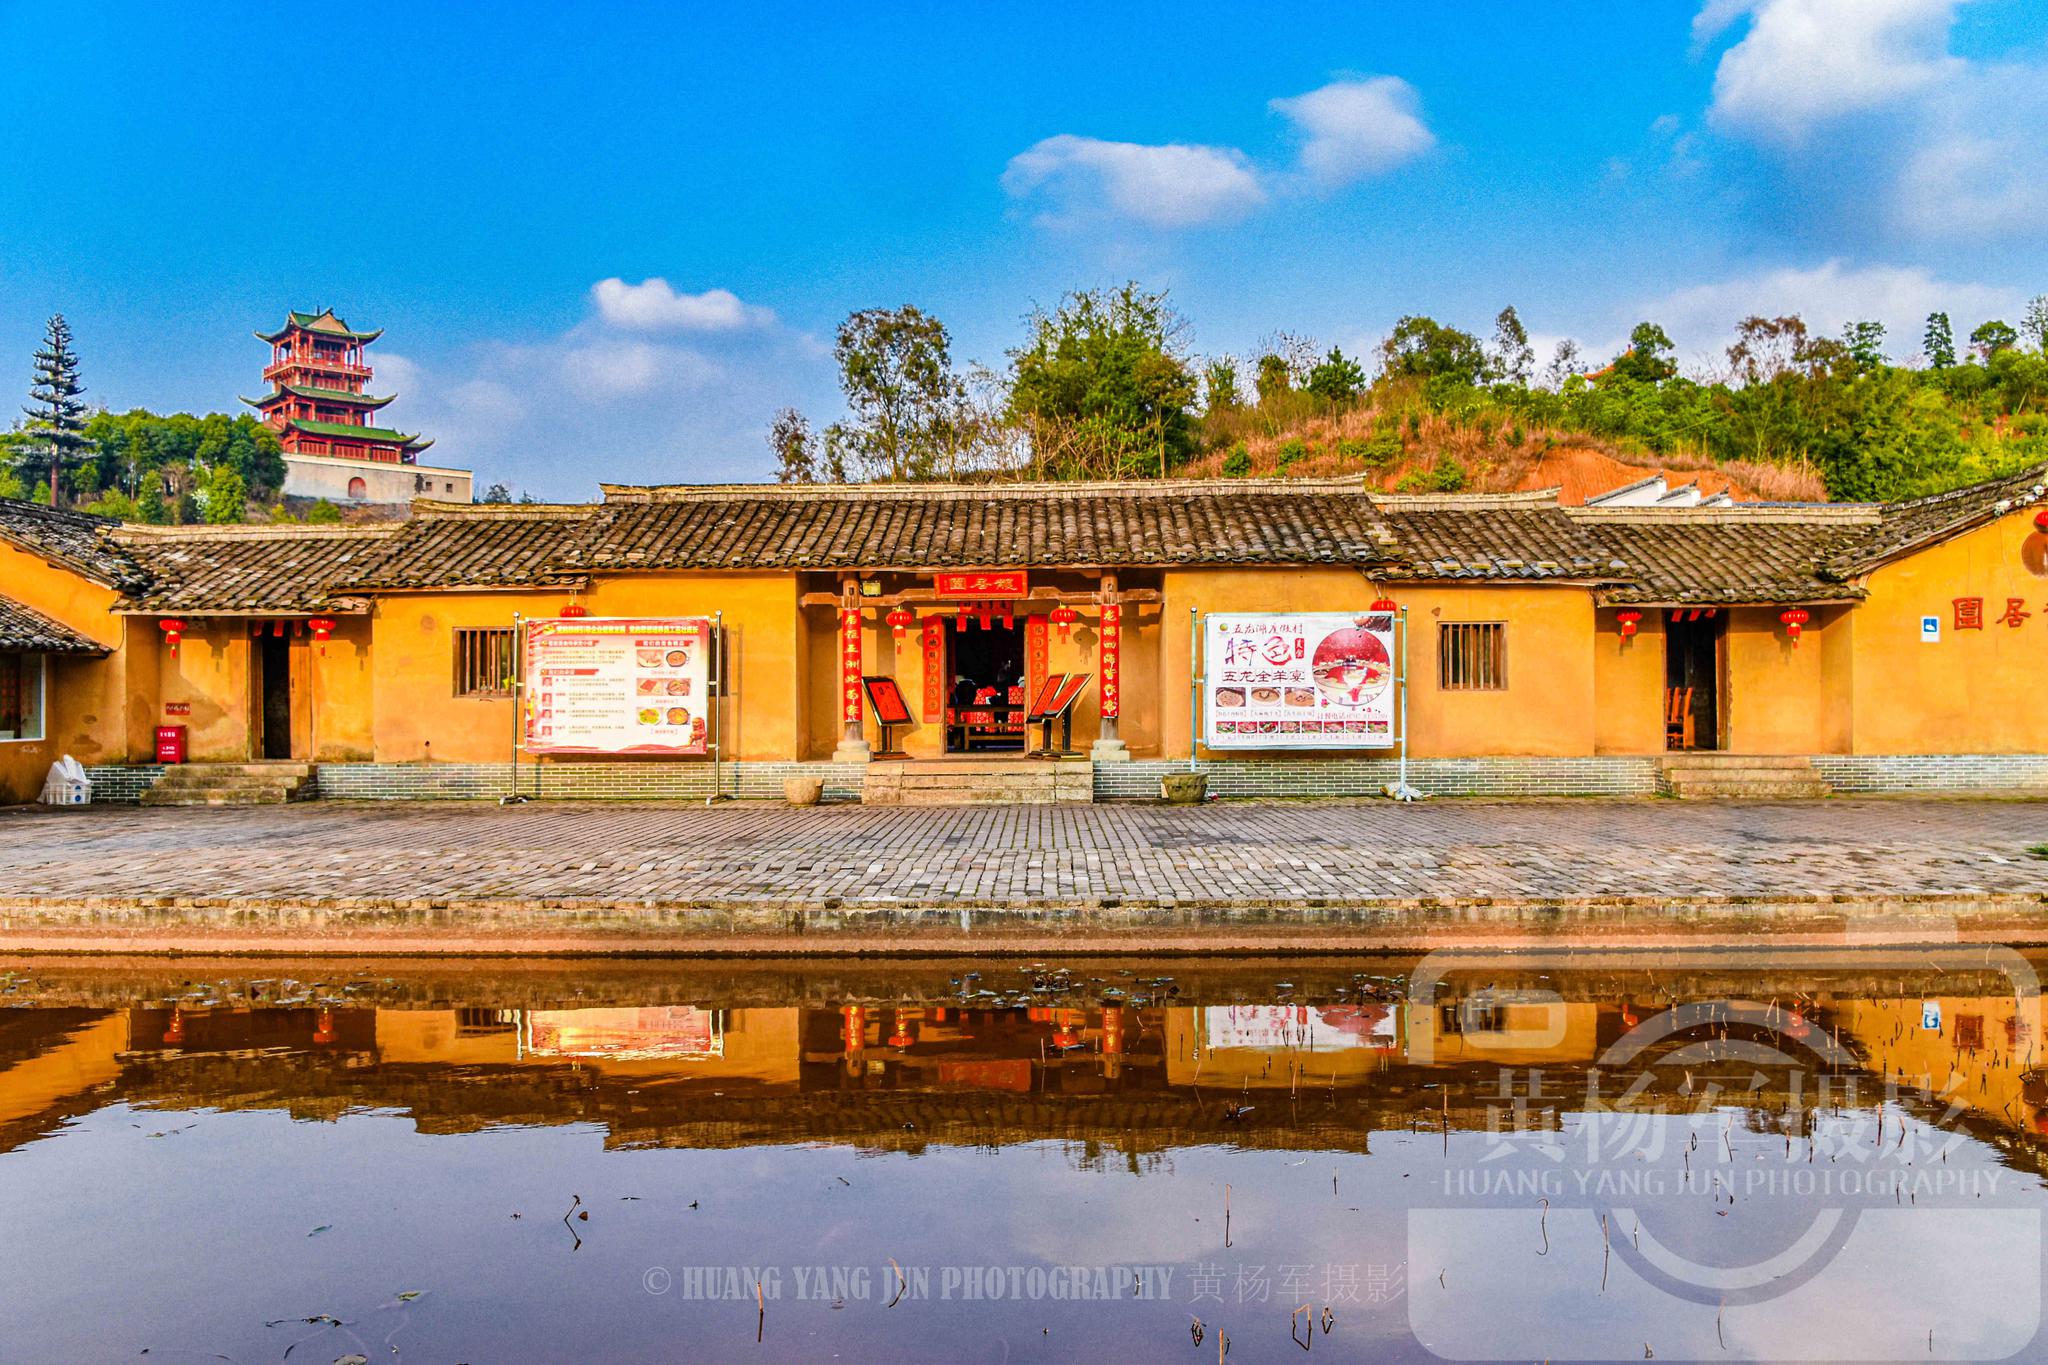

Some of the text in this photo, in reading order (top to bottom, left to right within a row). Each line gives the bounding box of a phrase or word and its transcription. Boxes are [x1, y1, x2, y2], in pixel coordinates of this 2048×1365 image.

[1222, 669, 1305, 683] 五龙全羊宴
